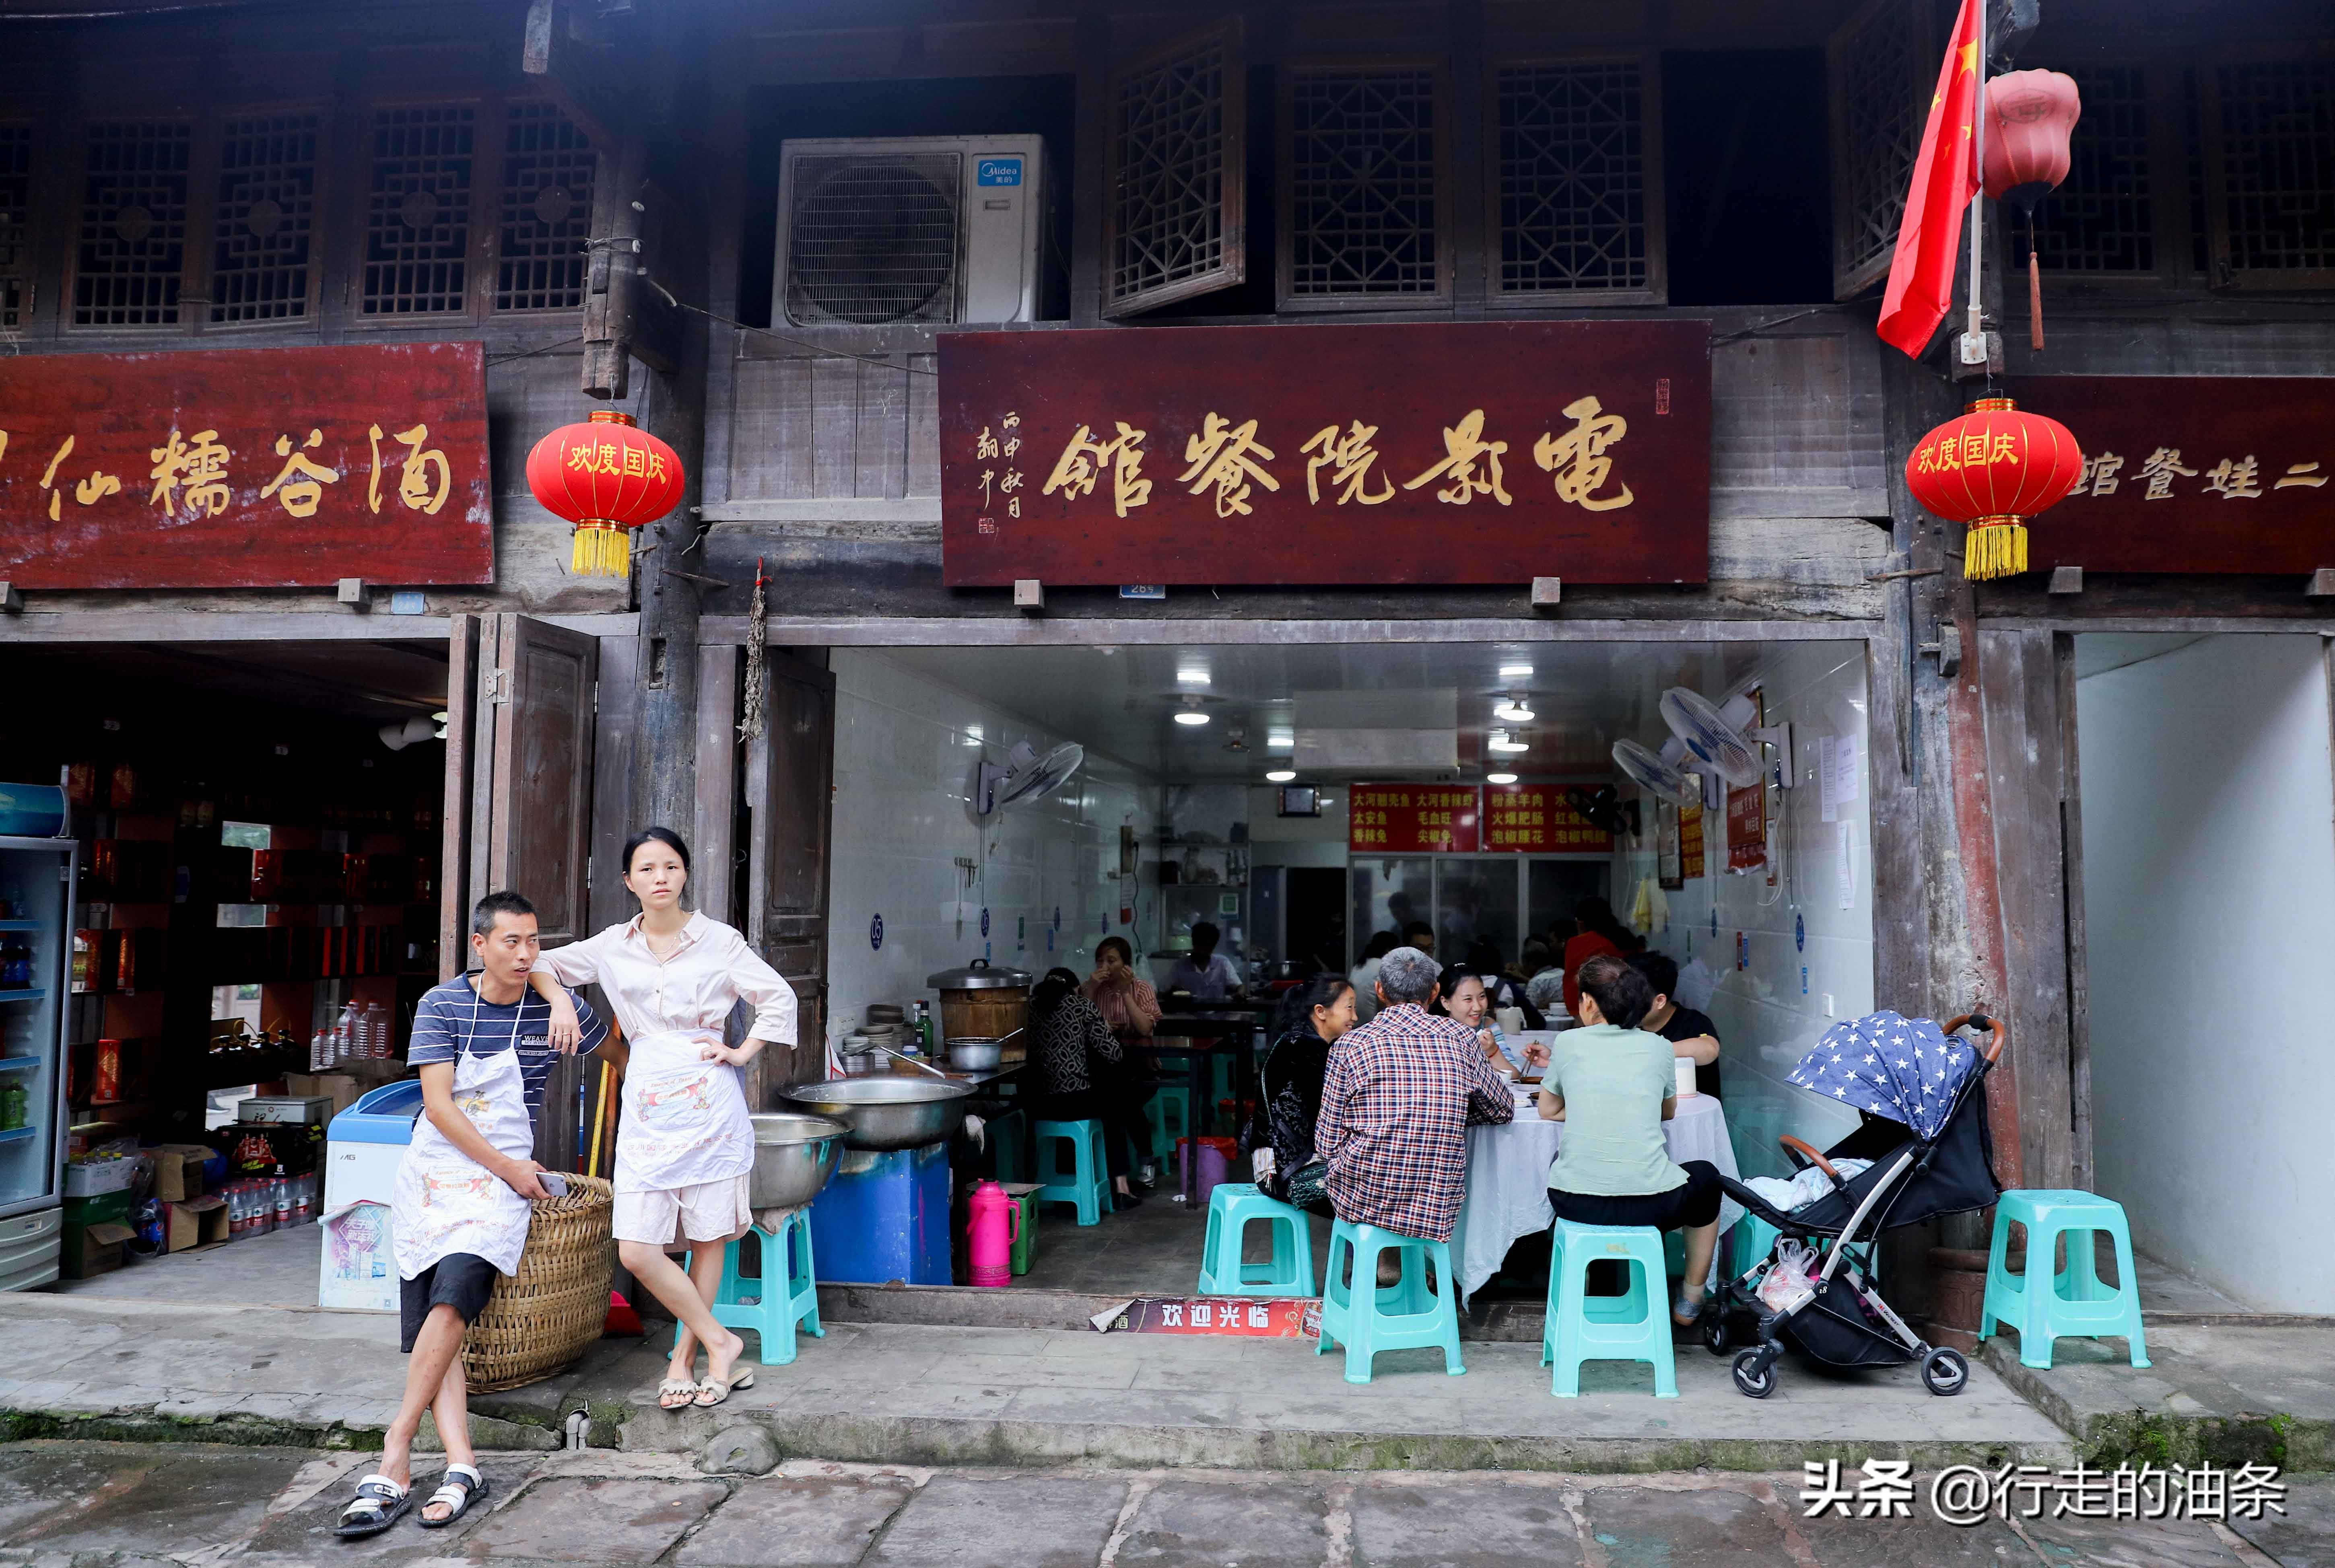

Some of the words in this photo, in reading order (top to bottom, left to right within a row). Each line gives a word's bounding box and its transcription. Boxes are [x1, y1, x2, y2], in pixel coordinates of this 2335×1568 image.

[982, 167, 1017, 175] Midea
[567, 443, 666, 484] 欢度国庆
[1918, 432, 2018, 474] 欢度国庆
[872, 918, 881, 939] 05
[1162, 1304, 1269, 1328] 欢迎光临
